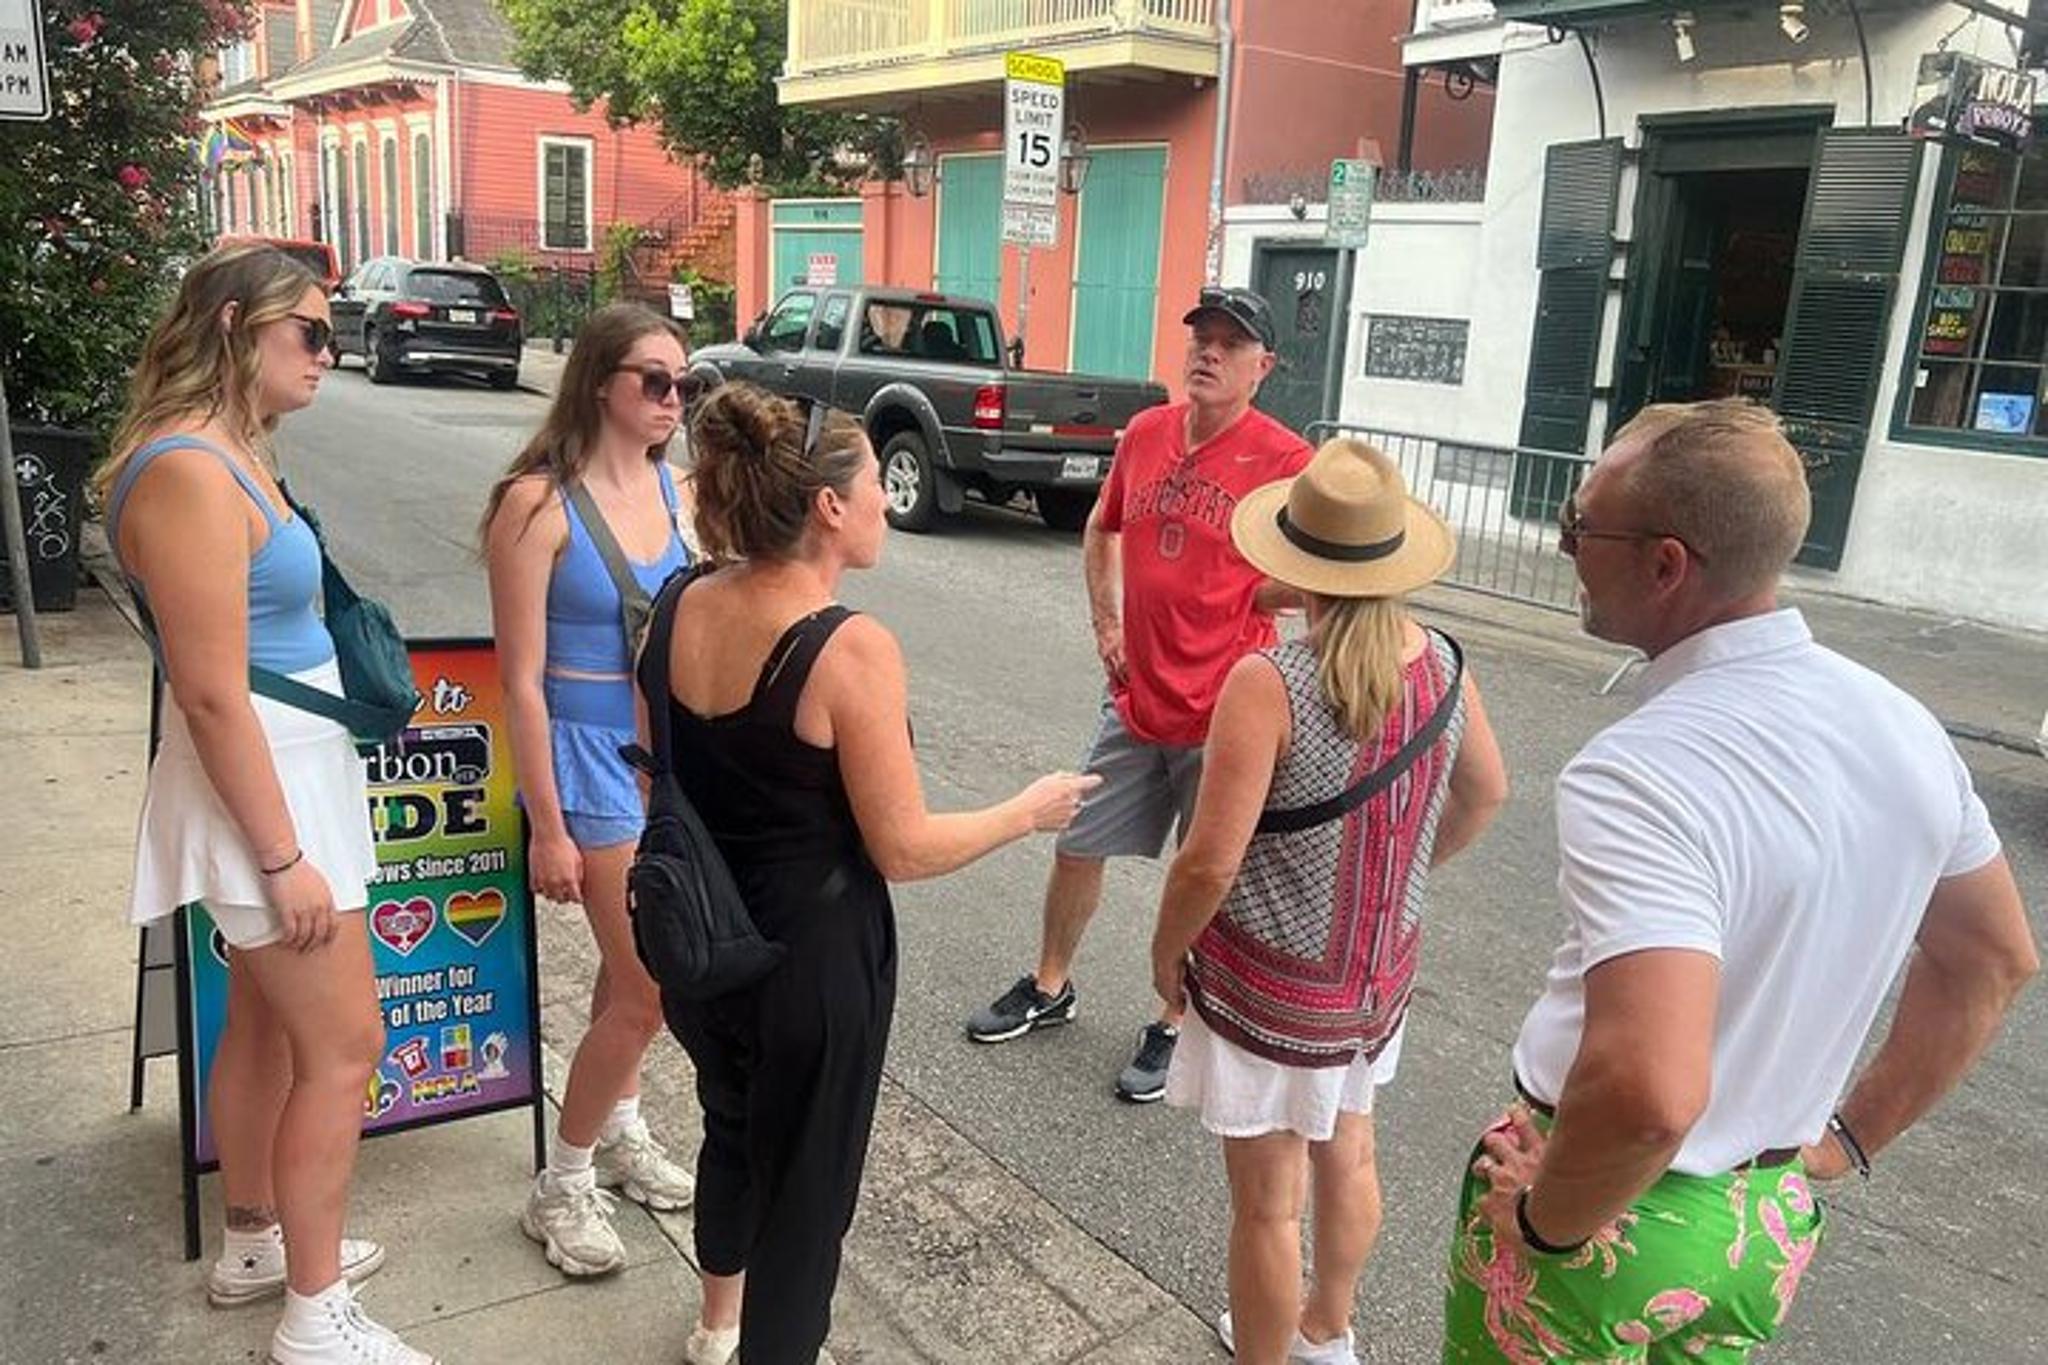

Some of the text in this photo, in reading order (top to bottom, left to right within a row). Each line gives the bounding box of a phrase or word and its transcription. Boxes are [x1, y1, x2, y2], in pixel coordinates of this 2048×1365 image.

[3, 44, 29, 63] AM
[1007, 58, 1060, 80] SCHOOL
[0, 74, 31, 94] PM
[1976, 67, 2032, 115] NOLA
[1012, 88, 1059, 109] SPEED
[1015, 109, 1054, 129] LIMIT
[1020, 131, 1050, 168] 15
[1333, 162, 1346, 184] 2
[1294, 271, 1326, 291] 910
[433, 679, 472, 713] to
[366, 850, 505, 884] ows Since 2011
[449, 966, 475, 988] for
[391, 1003, 411, 1027] of
[415, 1000, 447, 1022] the
[452, 992, 493, 1016] Year
